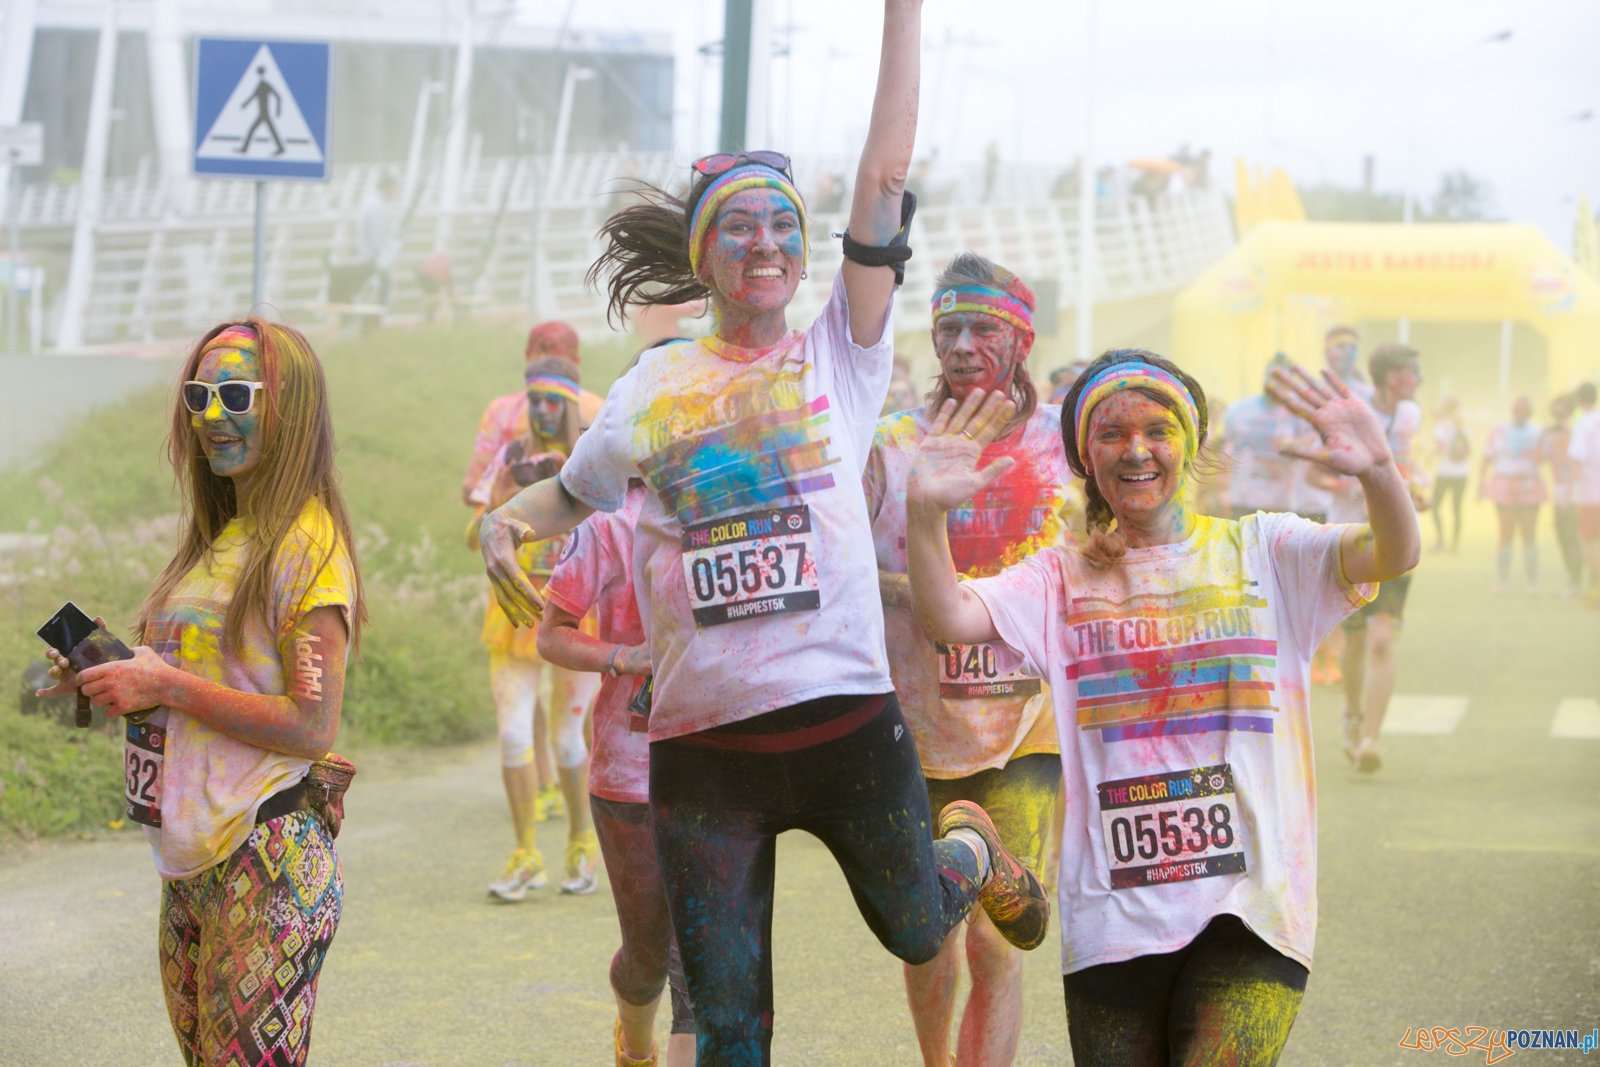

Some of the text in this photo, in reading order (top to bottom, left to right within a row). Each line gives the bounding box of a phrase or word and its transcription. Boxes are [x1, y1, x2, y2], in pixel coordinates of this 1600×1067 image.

[691, 529, 709, 546] THE
[711, 521, 748, 542] COLOR
[748, 518, 773, 535] RUN
[691, 542, 807, 601] 05537
[727, 597, 786, 619] #HAPPIEST5K
[1074, 607, 1255, 657] THE COLOR RUN
[295, 627, 323, 702] HAPPY
[1107, 787, 1129, 805] THE
[1129, 781, 1168, 802] COLOR
[1168, 778, 1194, 797] RUN
[1111, 803, 1234, 863] 05538
[1146, 862, 1209, 882] #HAPPIEST5K
